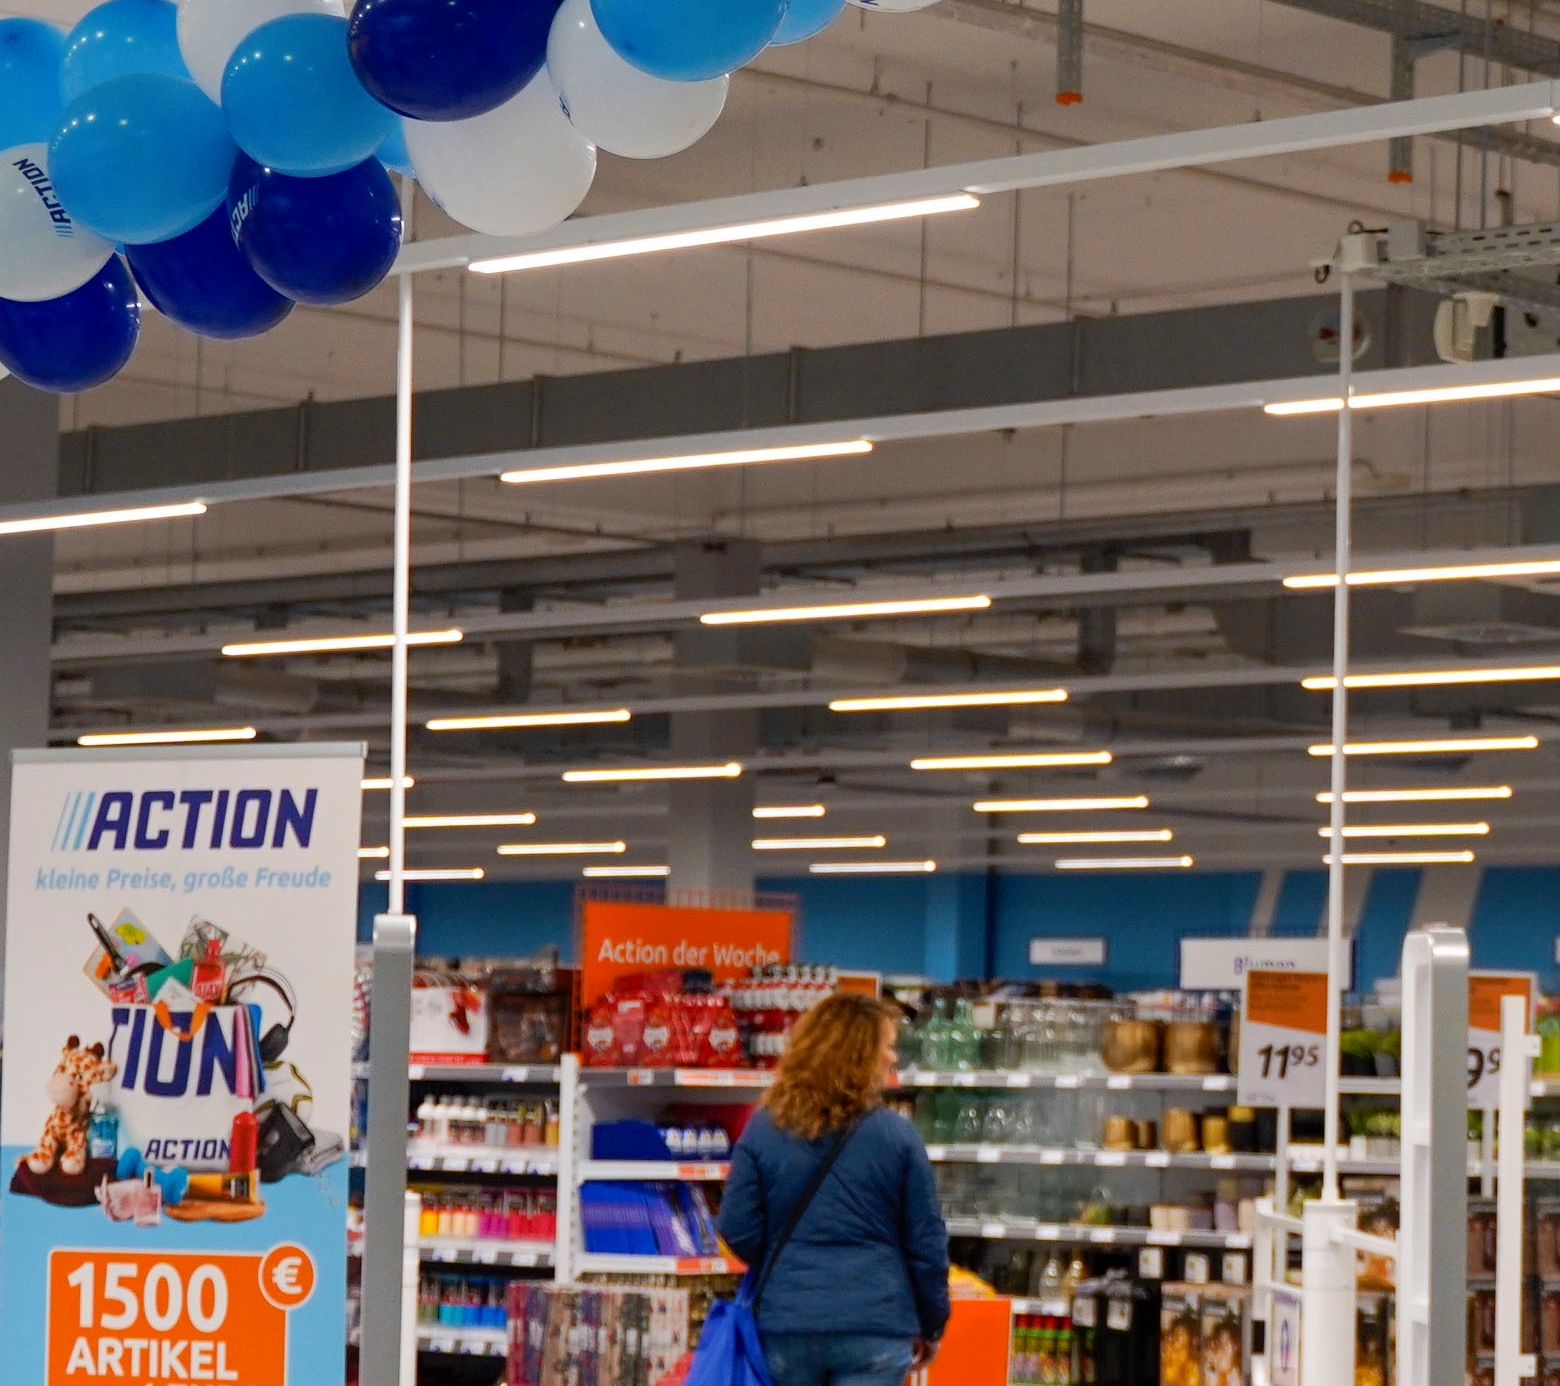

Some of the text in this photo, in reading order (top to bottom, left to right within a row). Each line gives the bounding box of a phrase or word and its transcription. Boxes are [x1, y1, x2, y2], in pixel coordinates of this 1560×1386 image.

[86, 789, 318, 852] ACTION
[36, 867, 331, 893] kleine Preise, große Freude
[598, 939, 780, 967] Action der Woche
[67, 1261, 229, 1333] 1500
[66, 1336, 238, 1381] ARTIKEL
